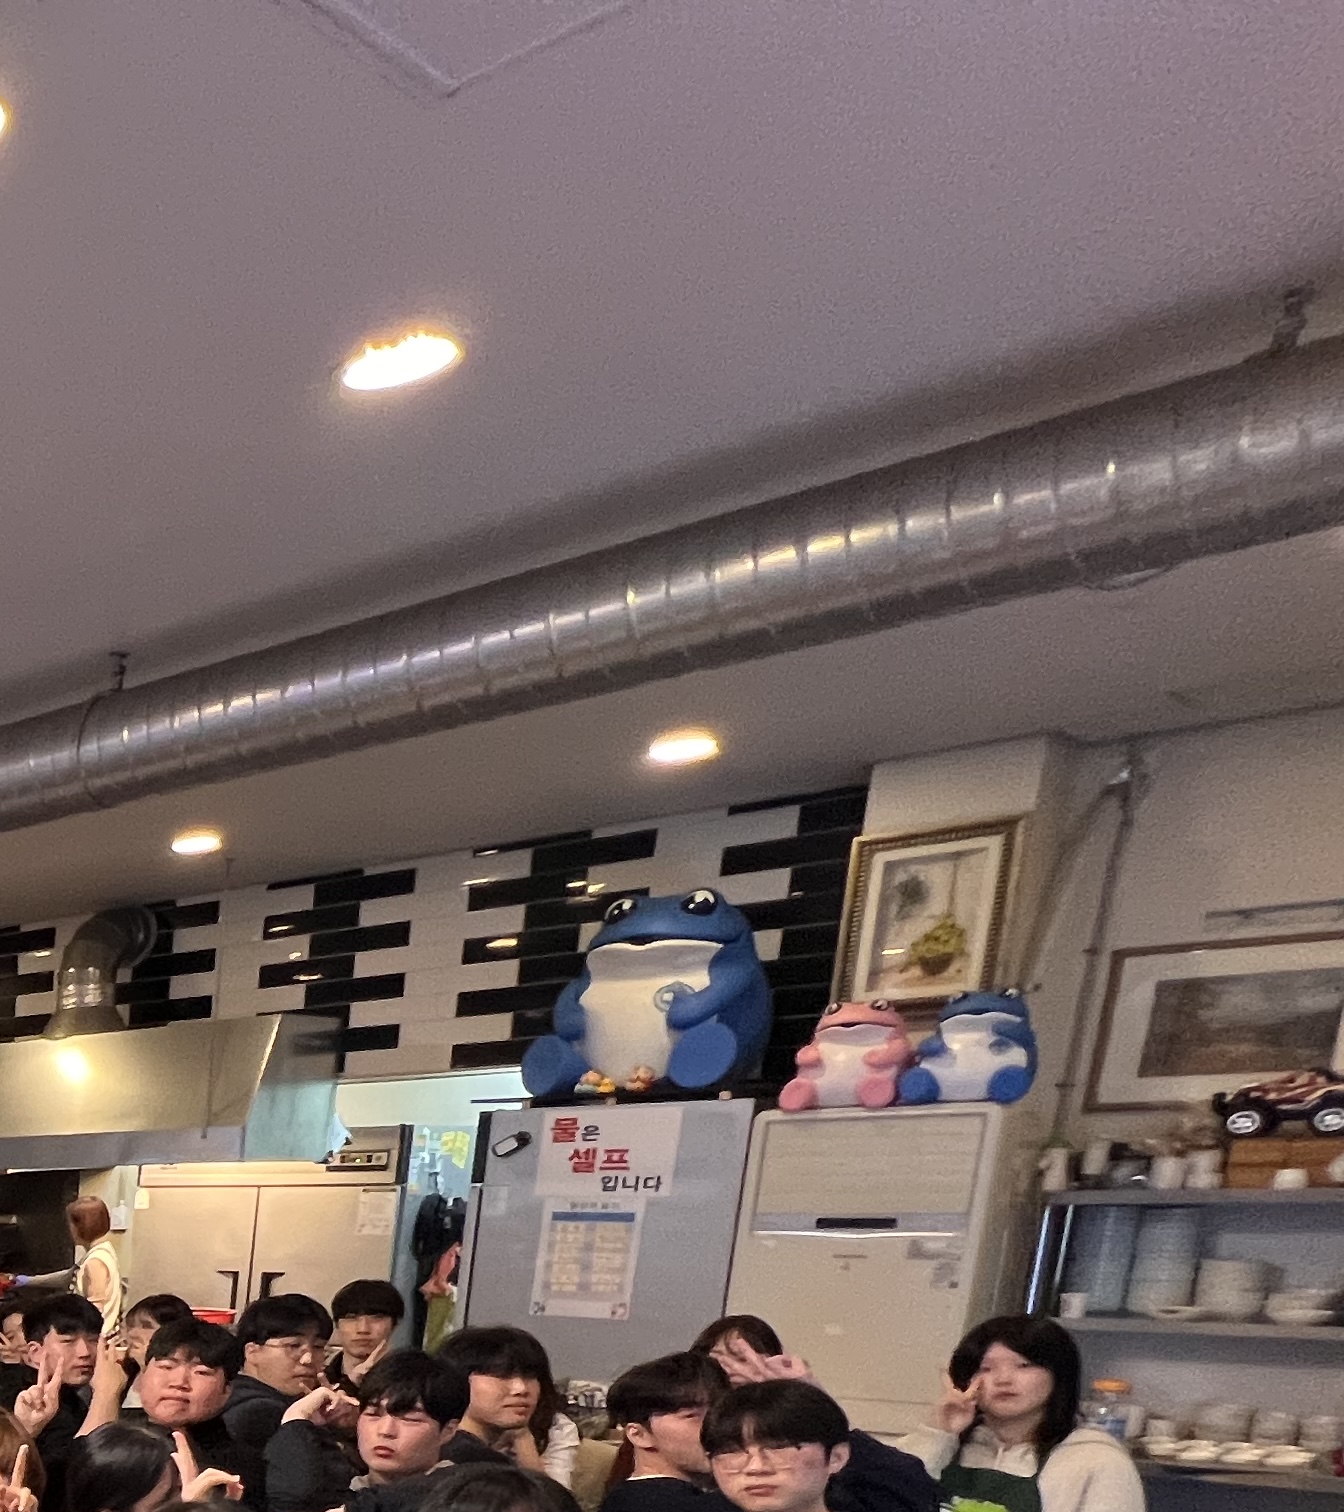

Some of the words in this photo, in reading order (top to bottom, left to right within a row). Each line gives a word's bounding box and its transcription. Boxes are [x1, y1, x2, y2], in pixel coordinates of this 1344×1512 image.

[550, 1117, 600, 1143] 물은
[568, 1148, 630, 1173] 셀프
[600, 1175, 662, 1193] 입니다
